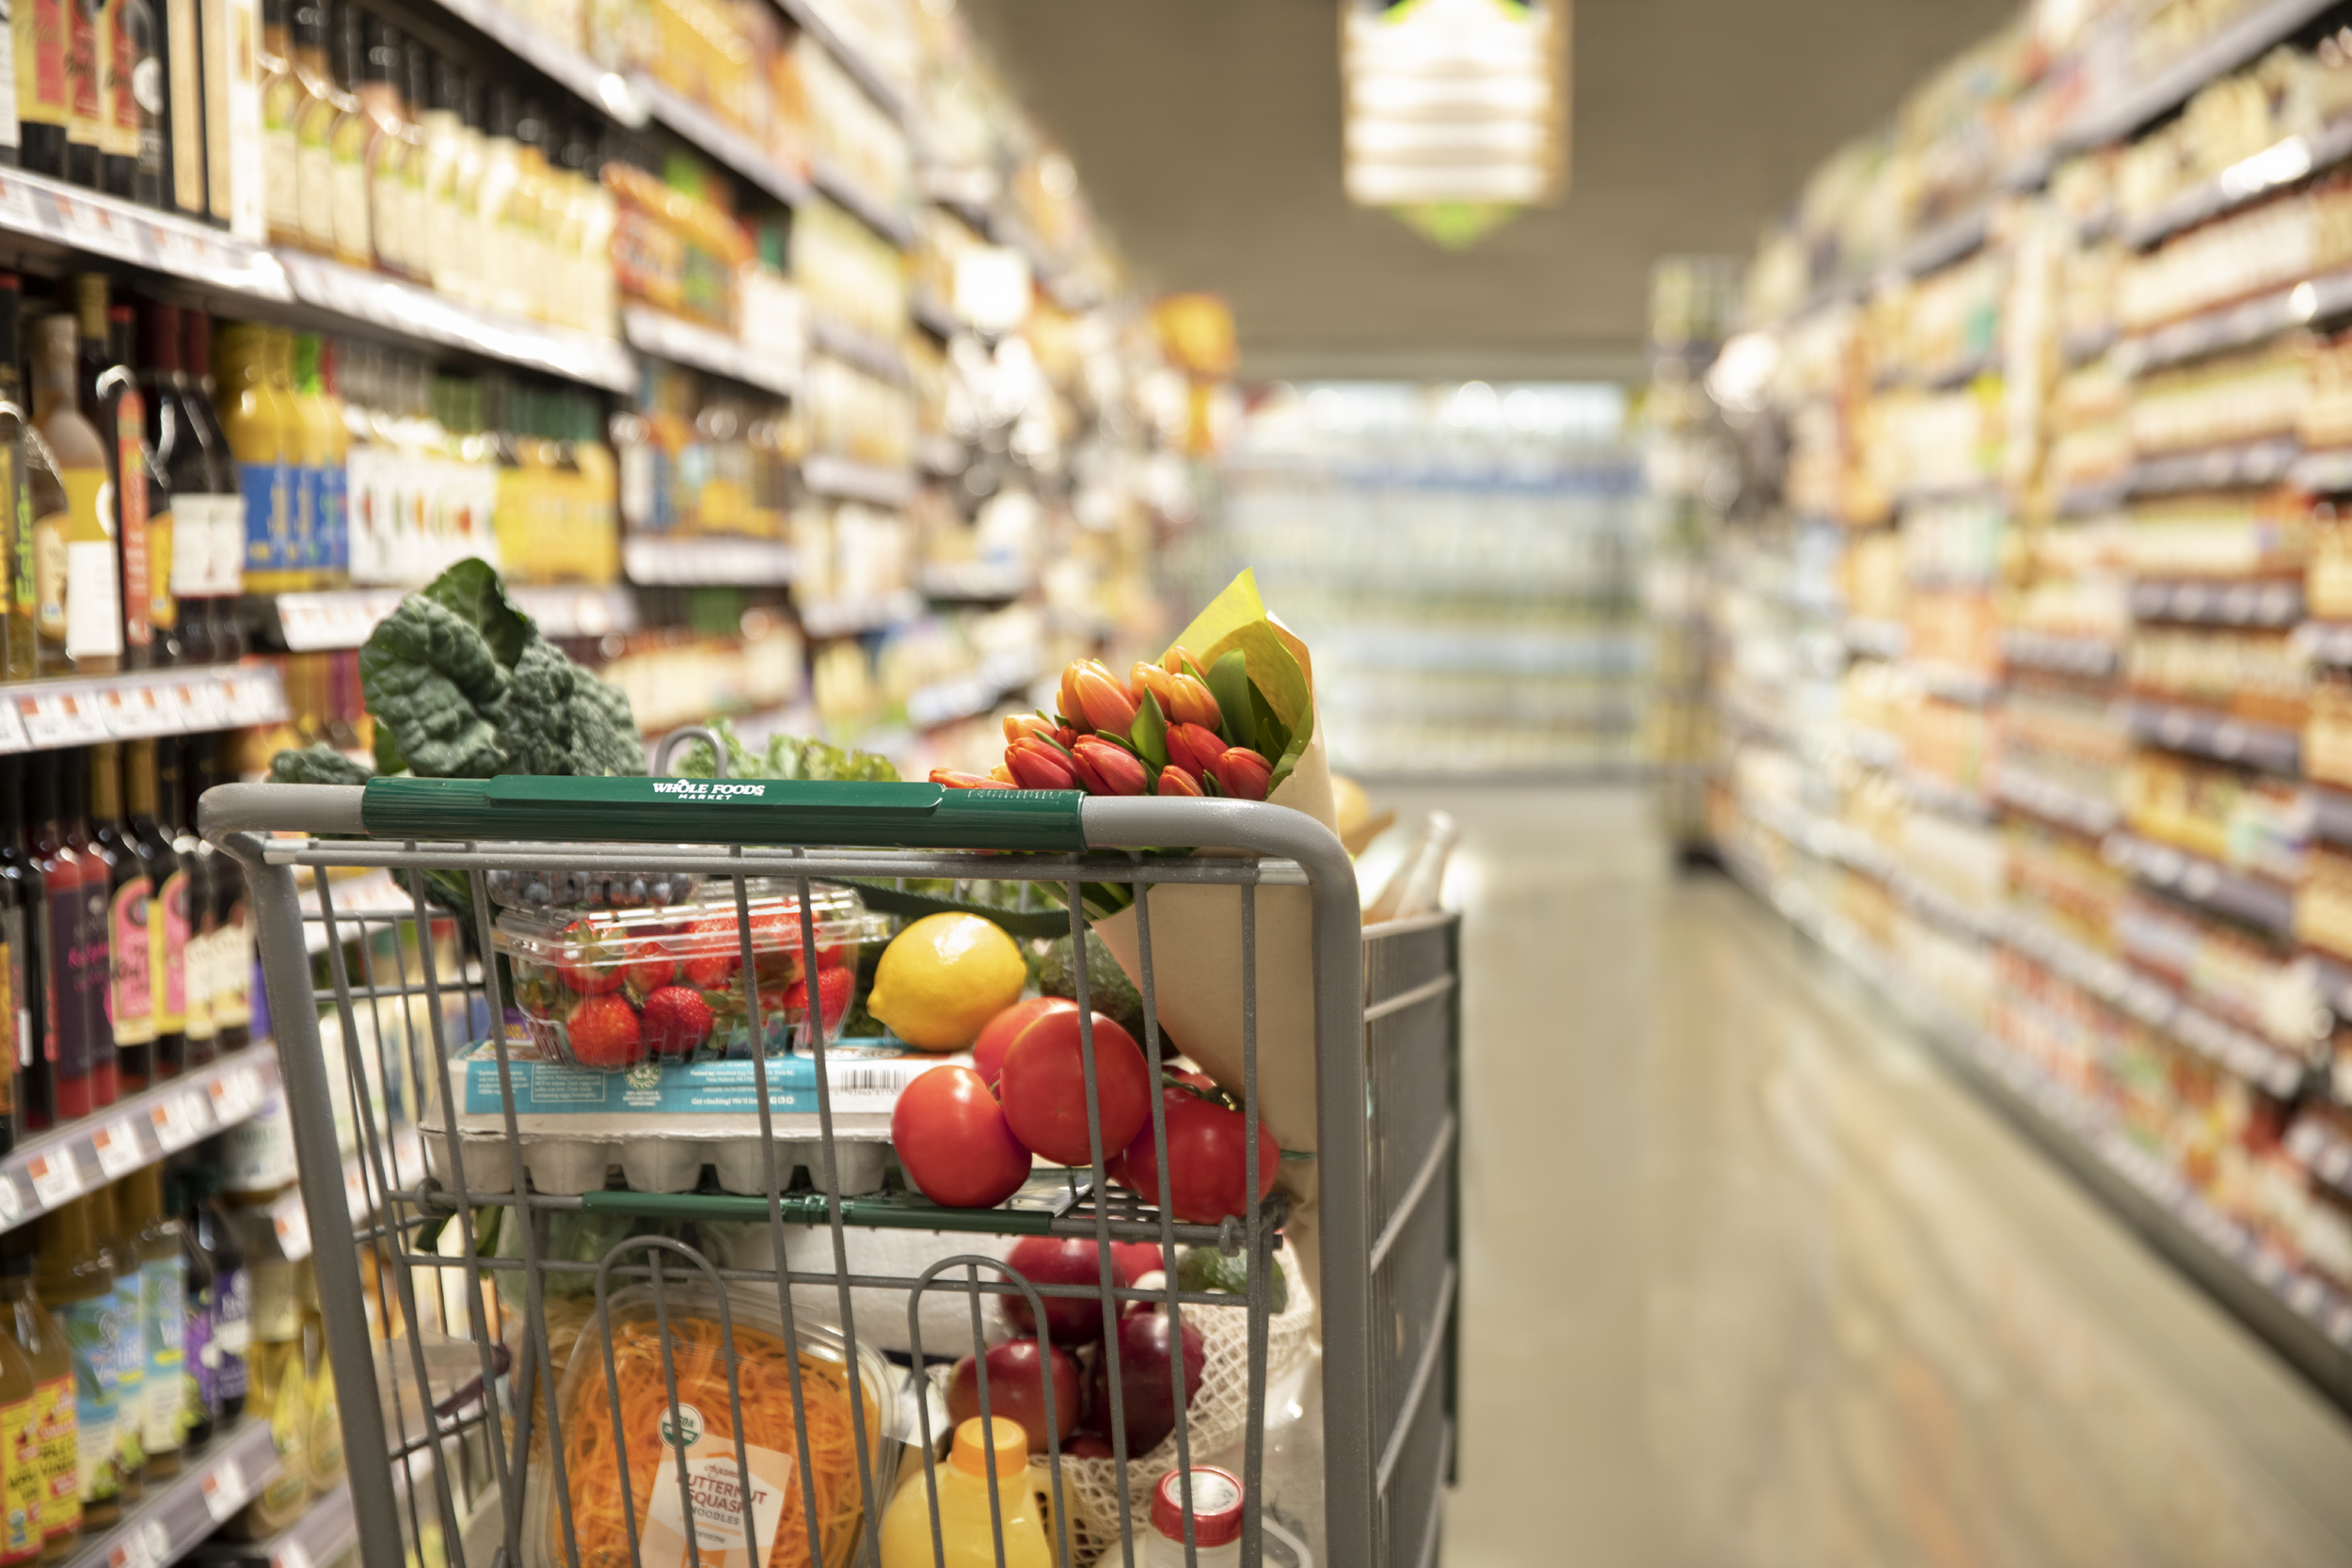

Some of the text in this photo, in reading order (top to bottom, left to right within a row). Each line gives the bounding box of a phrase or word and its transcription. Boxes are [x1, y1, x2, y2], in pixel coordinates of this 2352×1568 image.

[652, 779, 766, 796] WHOLE FOODS
[626, 1073, 659, 1088] RECYCLE
[703, 1098, 731, 1106] clucking!
